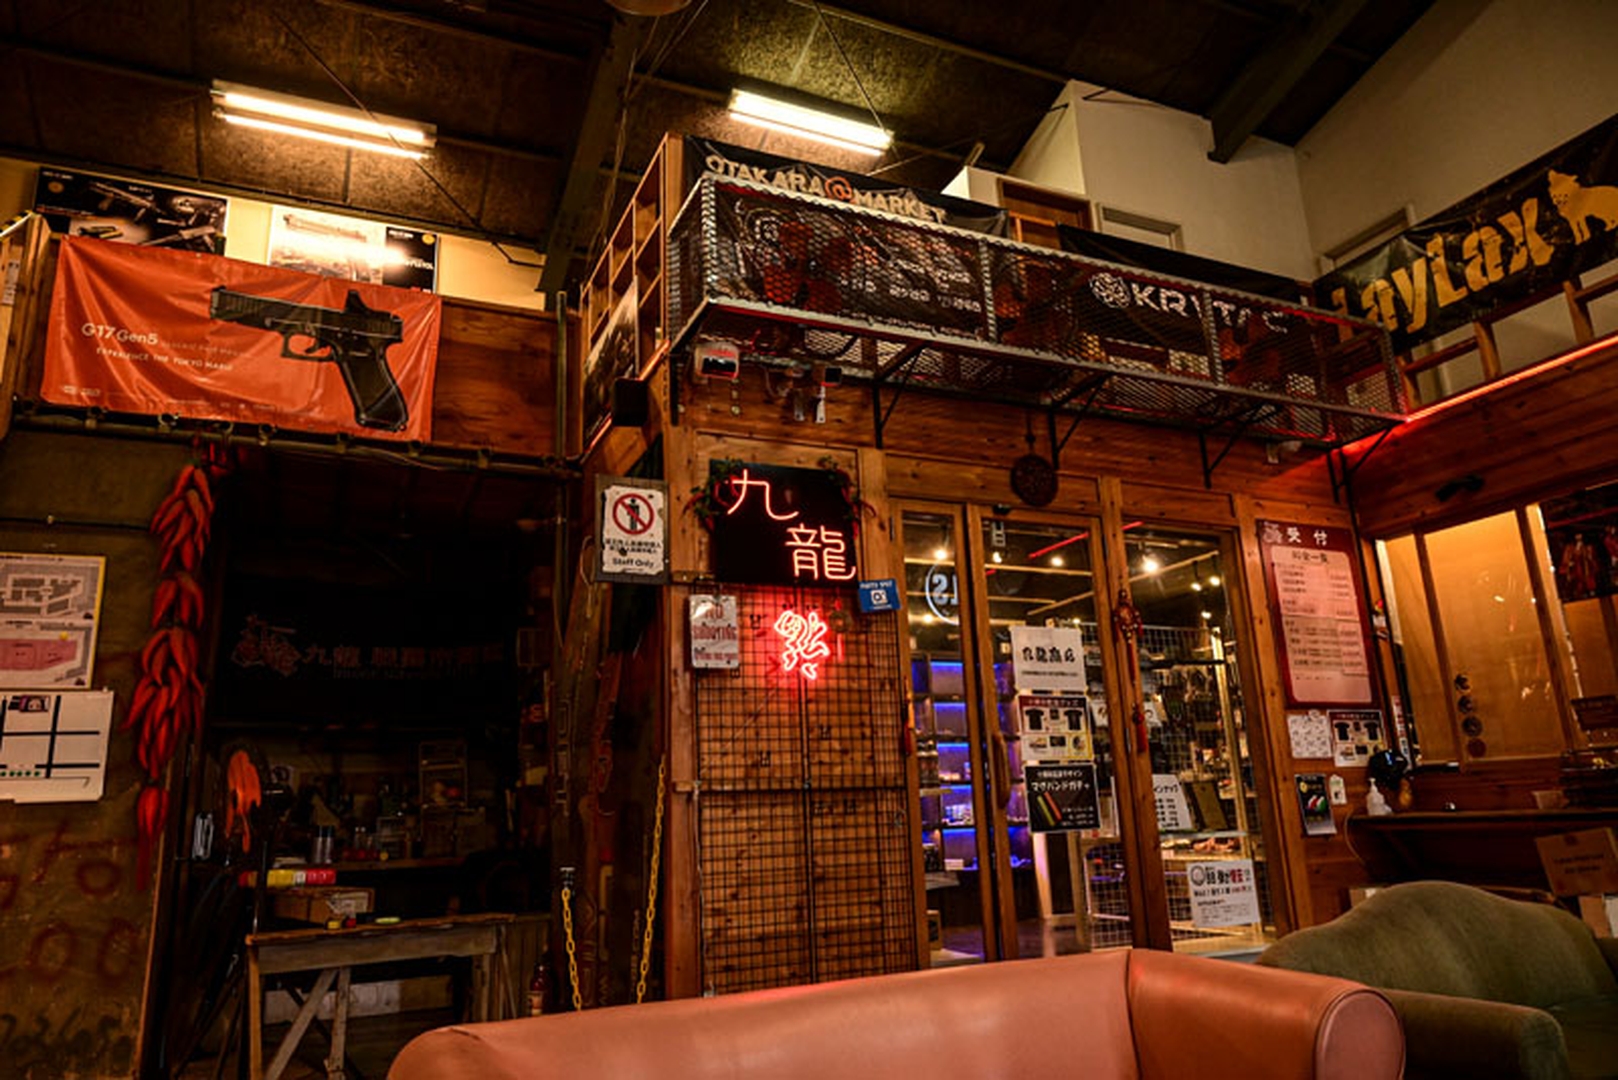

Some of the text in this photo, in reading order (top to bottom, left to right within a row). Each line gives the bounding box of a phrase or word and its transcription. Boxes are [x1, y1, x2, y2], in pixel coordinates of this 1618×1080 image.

[82, 321, 158, 346] G17 Gen5
[613, 557, 654, 569] Staff Only
